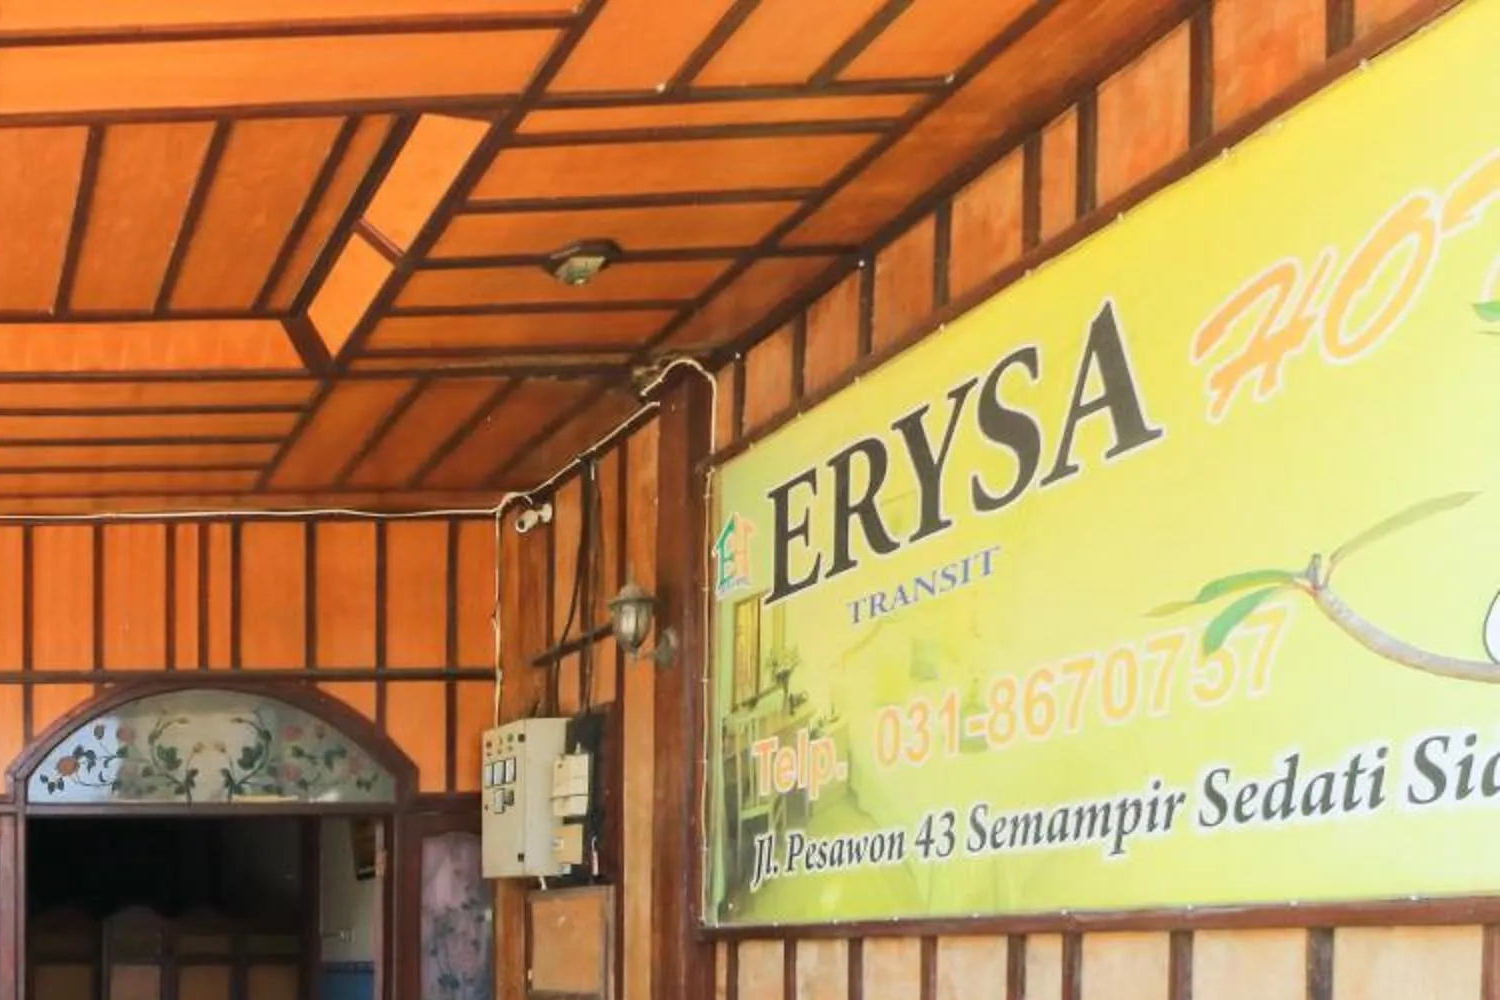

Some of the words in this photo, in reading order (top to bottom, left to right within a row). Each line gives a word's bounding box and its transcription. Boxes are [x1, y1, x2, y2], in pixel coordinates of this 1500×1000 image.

[763, 301, 1163, 606] ERYSA
[846, 545, 1000, 625] TRANSIT
[753, 726, 848, 800] Telp.
[874, 603, 1296, 770] 031-8670757
[752, 833, 778, 888] Jl.
[787, 831, 905, 873] Pesawon
[915, 810, 956, 858] 43
[967, 779, 1187, 856] Semampir
[1198, 745, 1389, 828] Sedati
